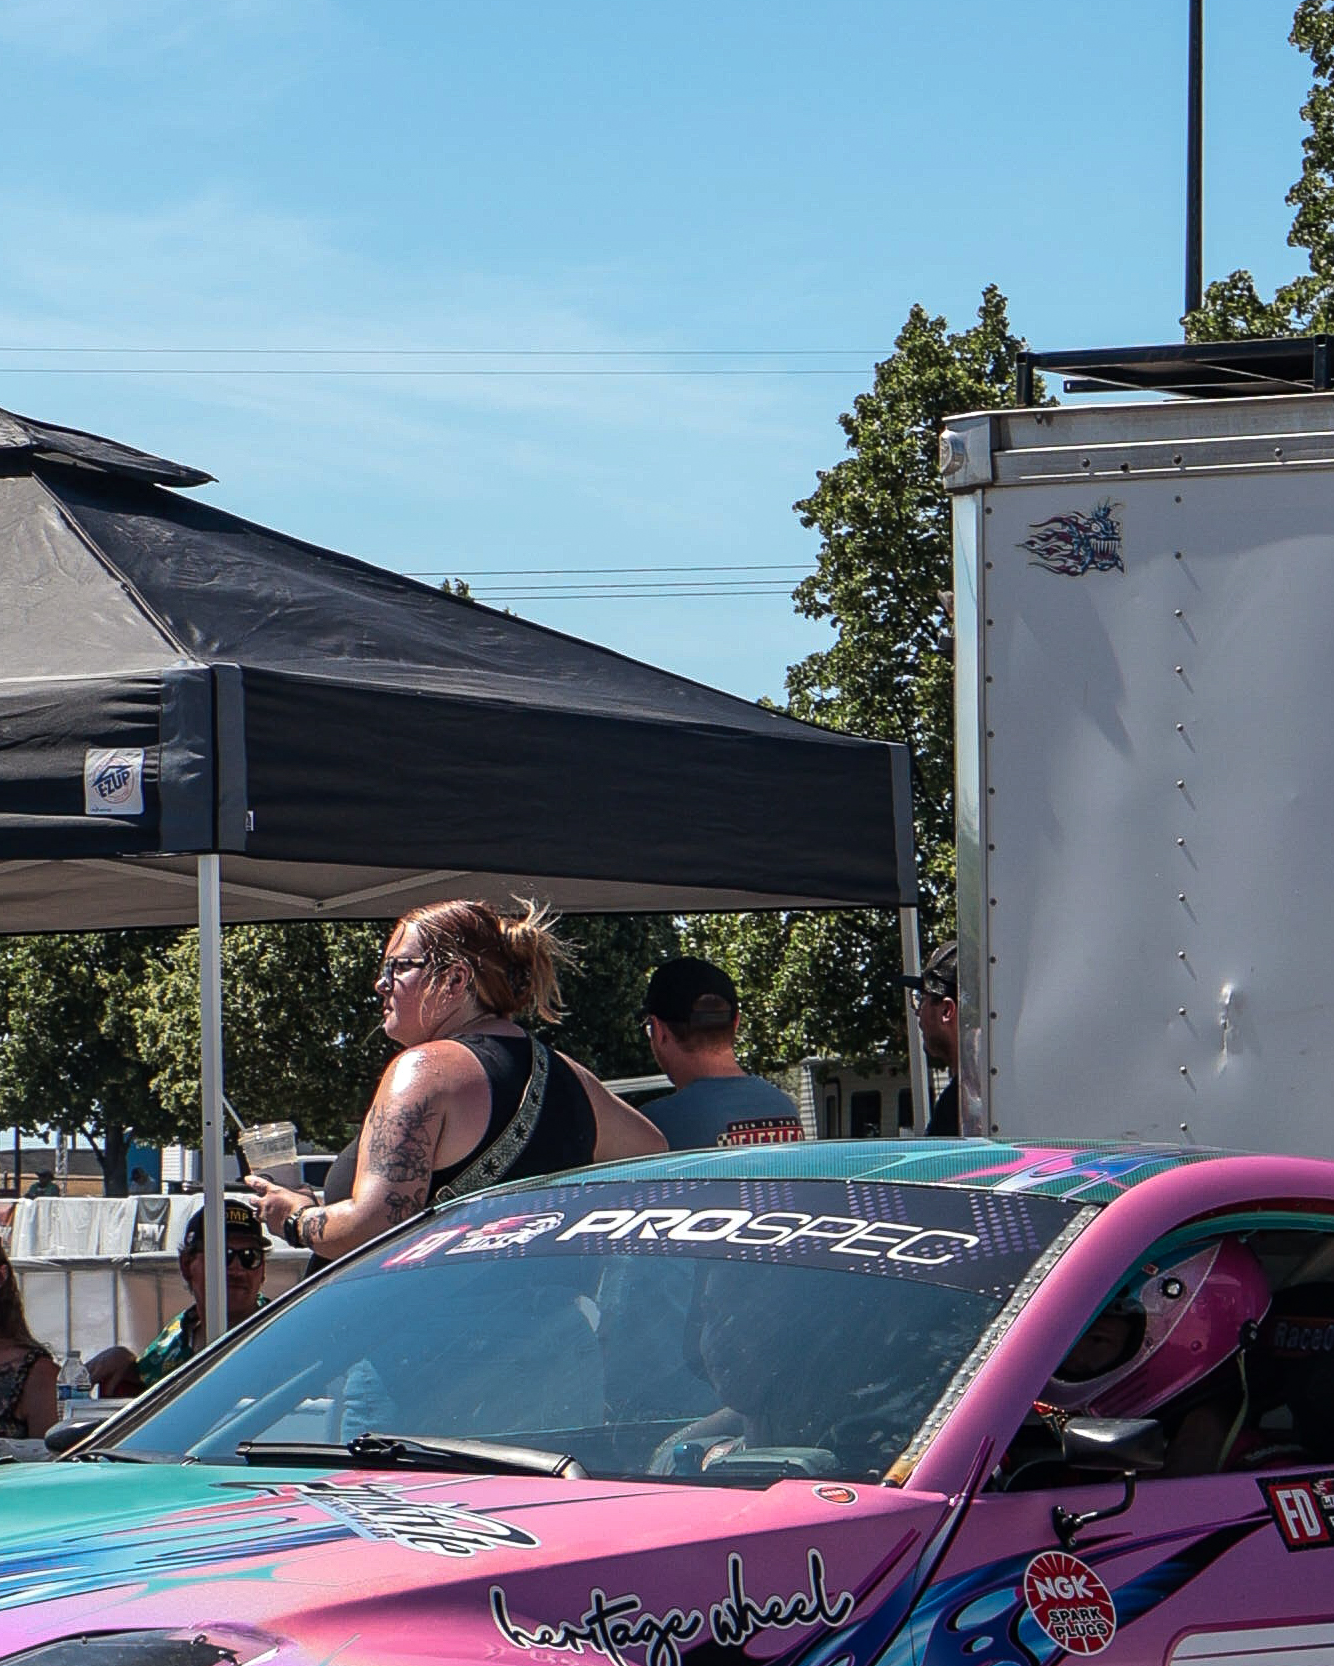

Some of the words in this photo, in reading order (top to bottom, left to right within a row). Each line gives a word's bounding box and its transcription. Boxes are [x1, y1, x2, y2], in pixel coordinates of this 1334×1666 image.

[1276, 1488, 1321, 1539] FD
[710, 1548, 855, 1645] wheel
[1034, 1574, 1094, 1601] NGK
[1048, 1606, 1102, 1624] SPARK
[1053, 1622, 1109, 1639] PLUGS
